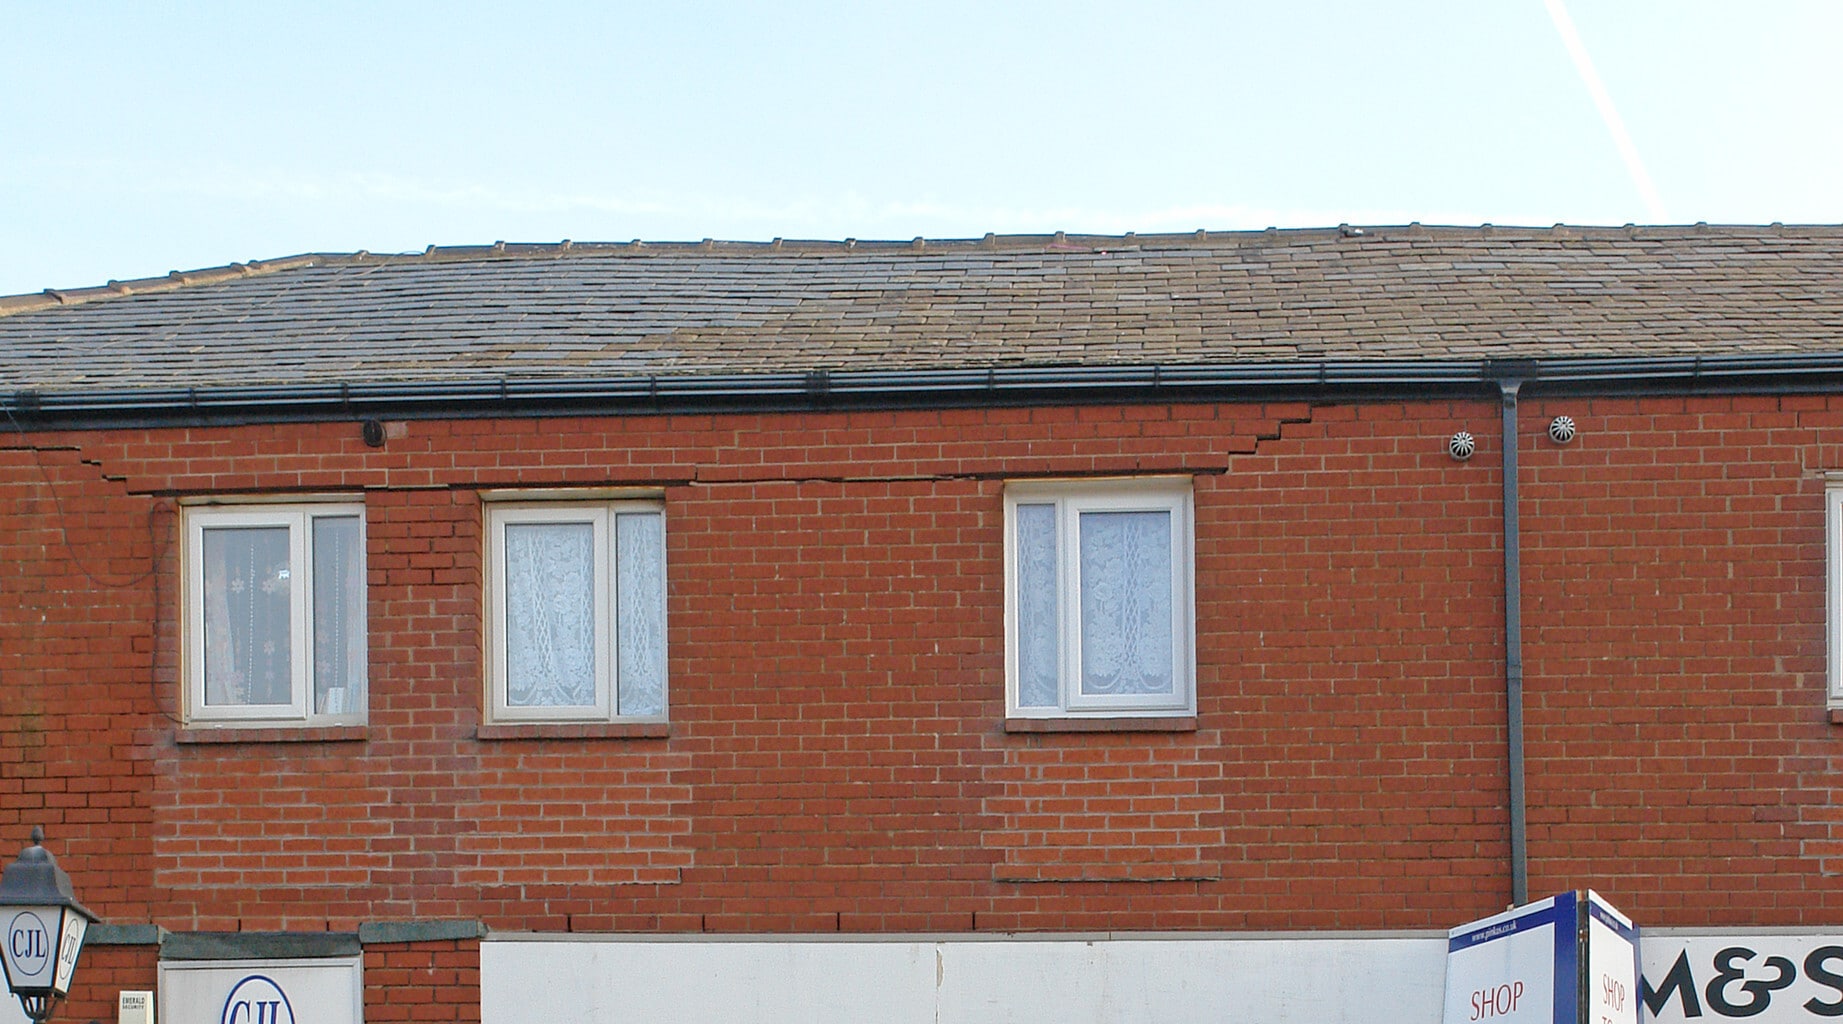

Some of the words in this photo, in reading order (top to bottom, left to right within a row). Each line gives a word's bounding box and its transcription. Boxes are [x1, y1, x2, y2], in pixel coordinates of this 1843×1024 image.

[12, 929, 46, 958] CJL
[122, 997, 145, 1005] EMERALD
[1471, 981, 1524, 1021] SHOP
[1602, 974, 1625, 1012] SHOP
